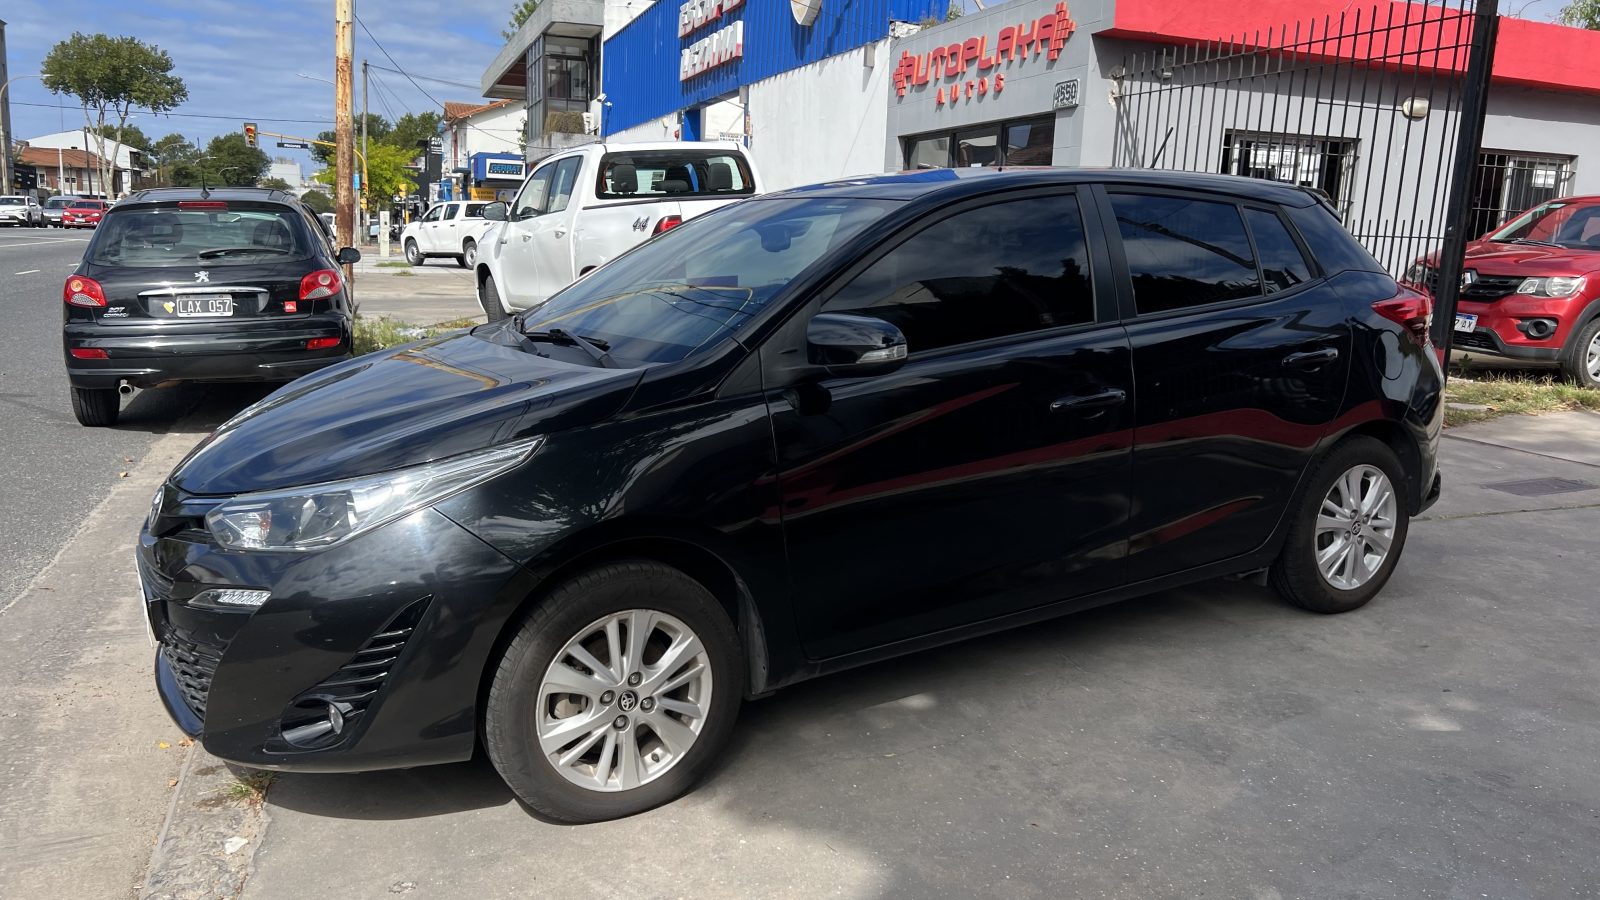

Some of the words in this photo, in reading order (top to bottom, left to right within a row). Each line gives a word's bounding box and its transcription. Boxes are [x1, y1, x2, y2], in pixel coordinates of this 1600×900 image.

[936, 73, 1005, 105] AUTOS
[180, 300, 202, 313] LAX
[208, 300, 231, 313] 057
